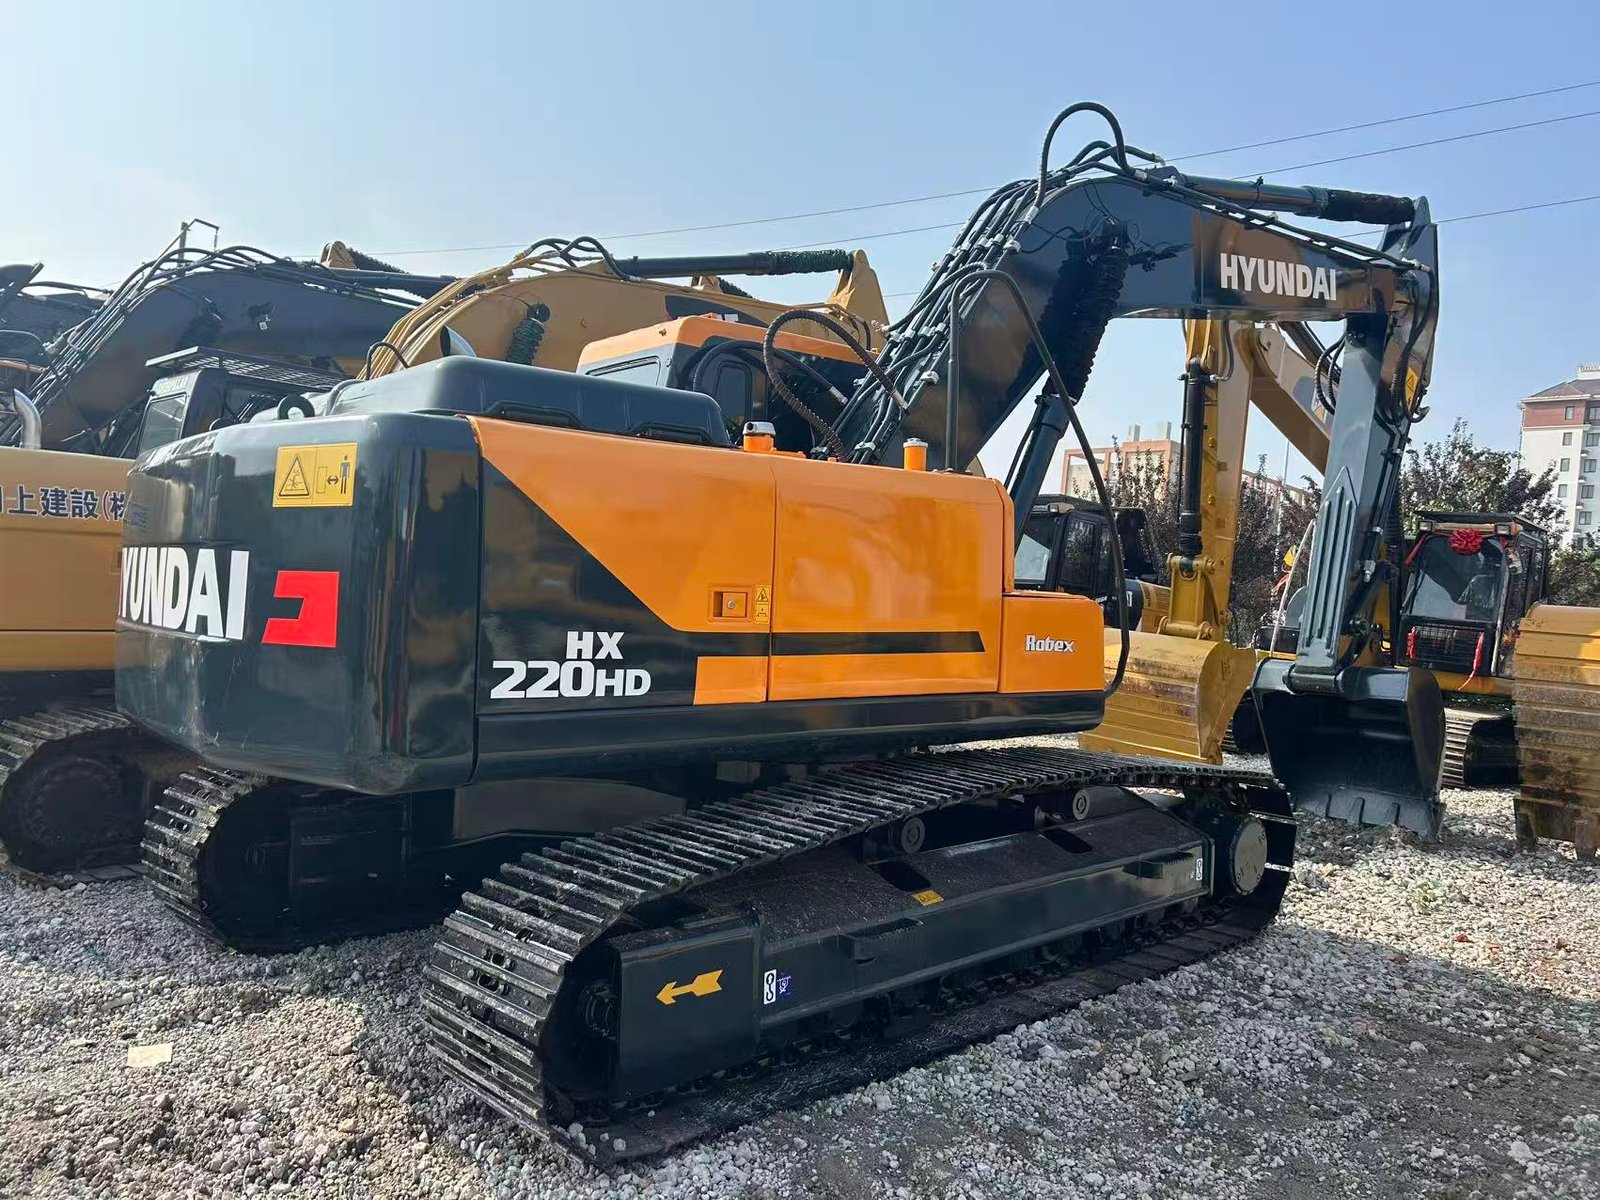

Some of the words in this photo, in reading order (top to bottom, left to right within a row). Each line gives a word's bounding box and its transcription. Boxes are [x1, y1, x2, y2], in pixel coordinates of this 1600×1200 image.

[1220, 252, 1337, 300] HYUNDAI
[118, 547, 249, 640] YUNDAI
[566, 631, 624, 659] HX
[1025, 634, 1075, 652] Robex
[490, 660, 651, 698] 220HD
